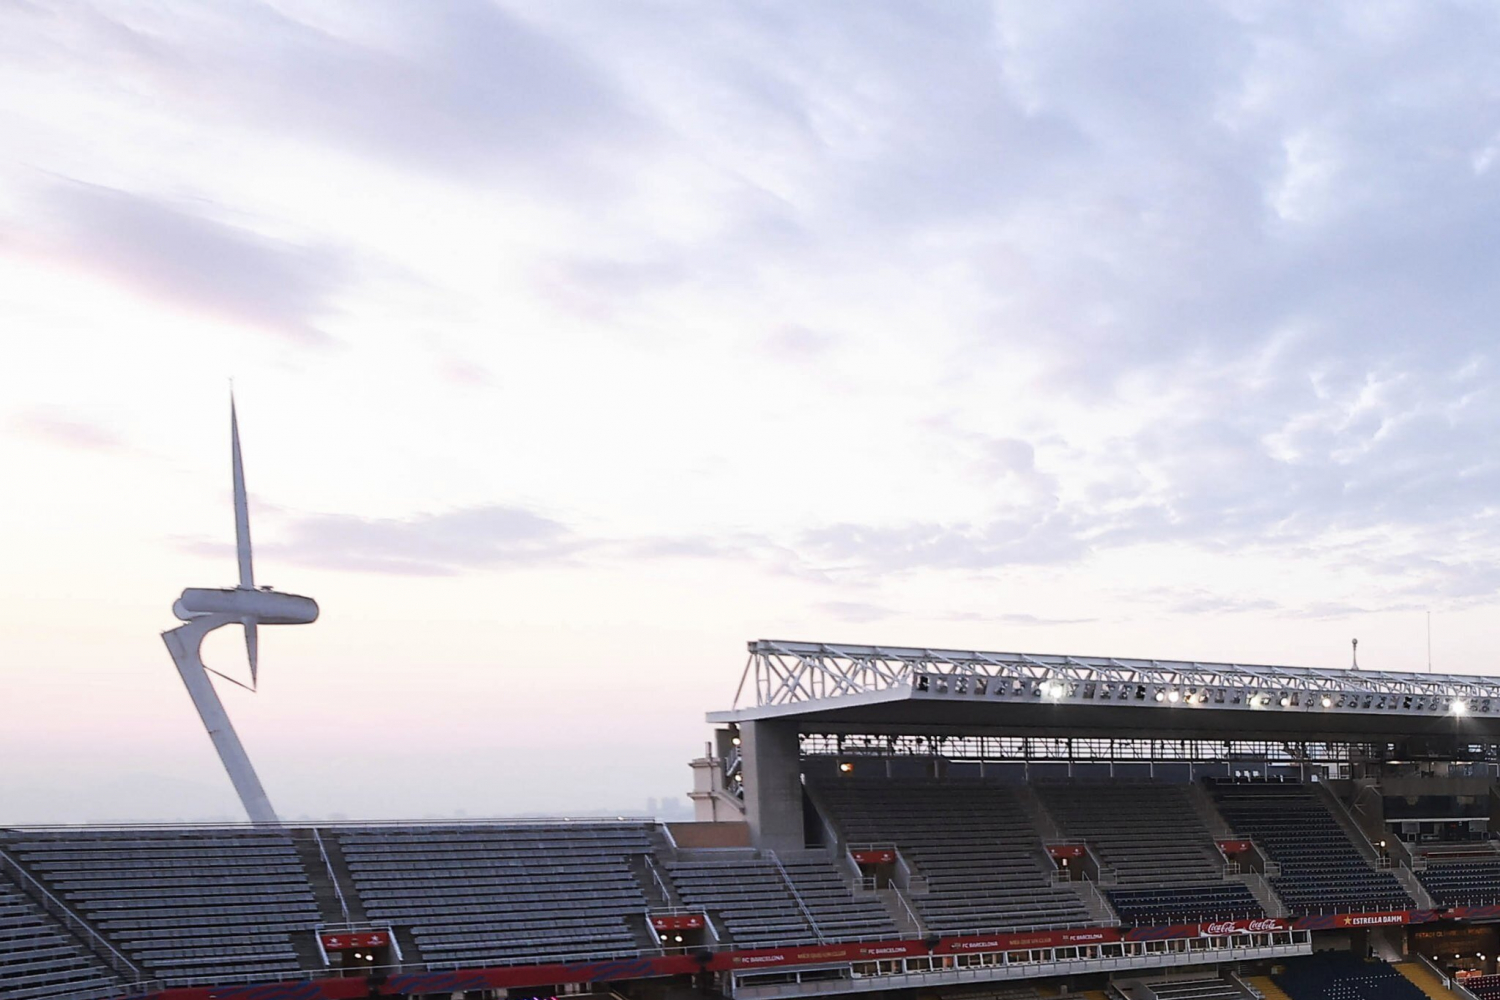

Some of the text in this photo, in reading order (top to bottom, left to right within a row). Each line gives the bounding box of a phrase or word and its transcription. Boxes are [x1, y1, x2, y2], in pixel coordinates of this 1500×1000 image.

[1249, 919, 1277, 931] Coca-Cola
[1352, 915, 1402, 925] ESTRELLA DAMM
[1207, 921, 1237, 933] Coca-Cola
[750, 954, 784, 962] BARCELONA
